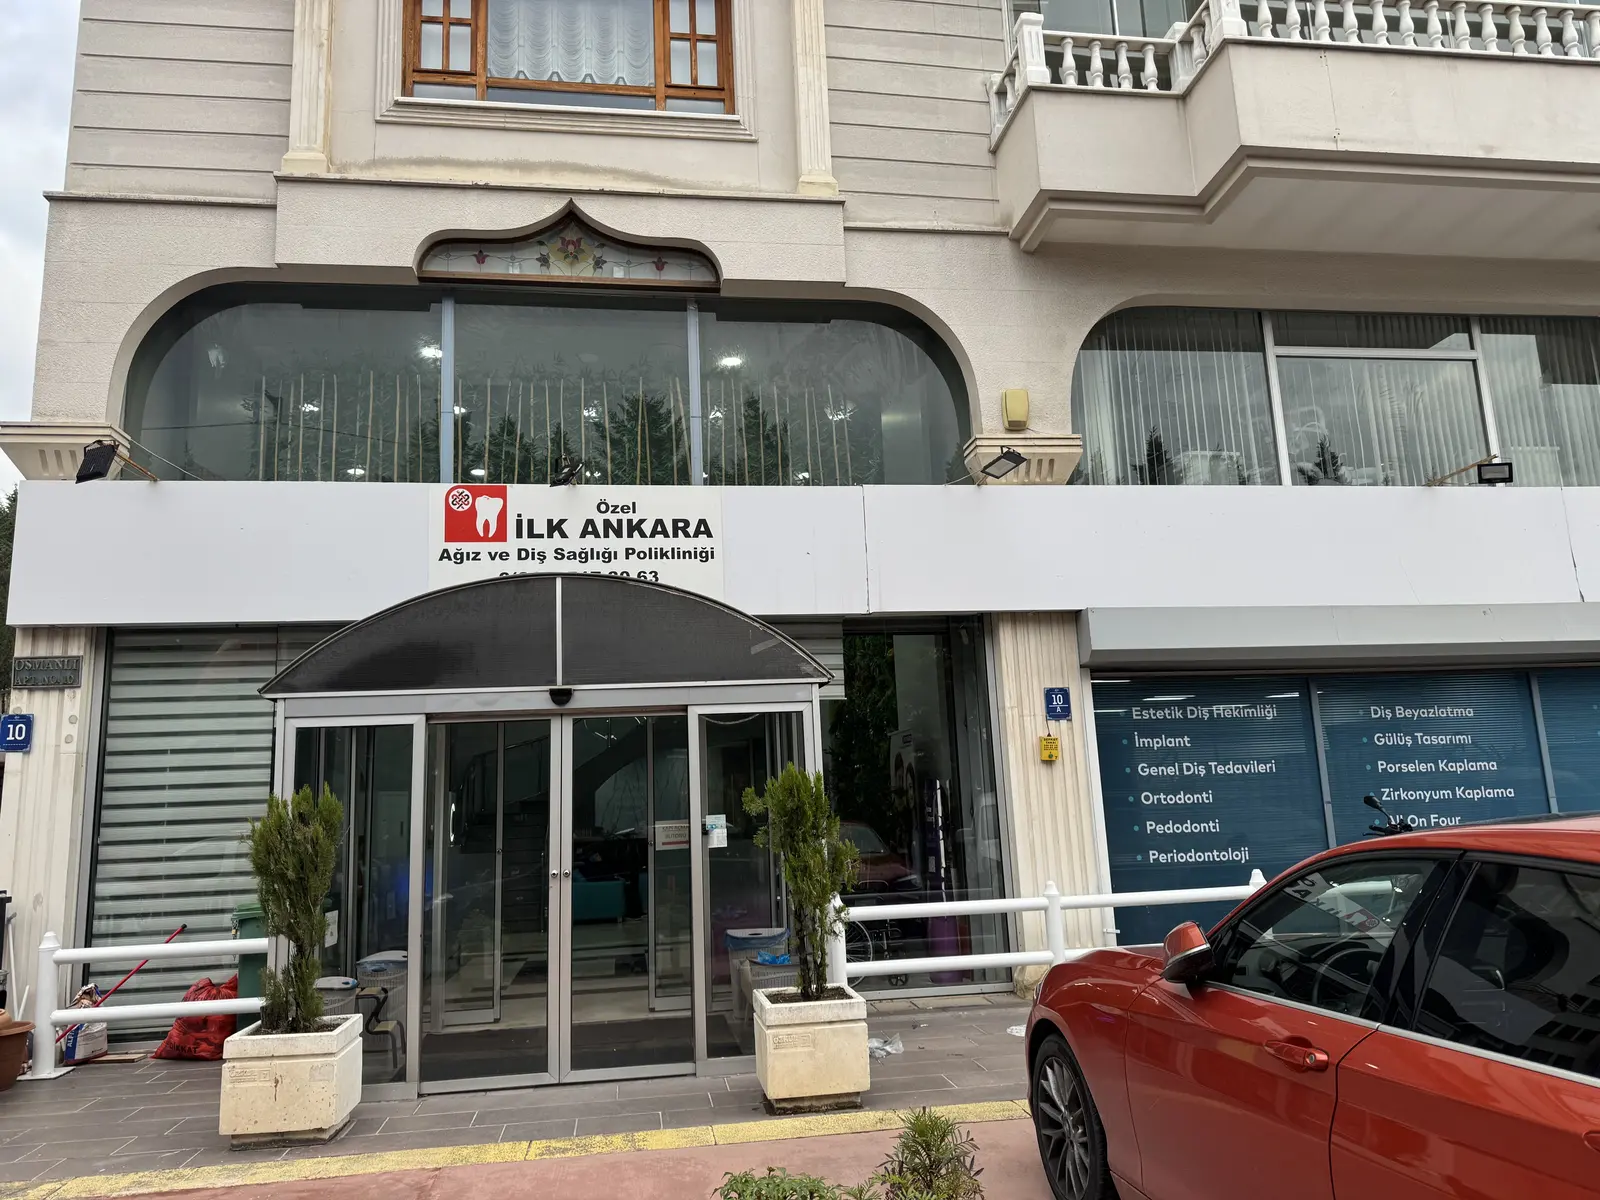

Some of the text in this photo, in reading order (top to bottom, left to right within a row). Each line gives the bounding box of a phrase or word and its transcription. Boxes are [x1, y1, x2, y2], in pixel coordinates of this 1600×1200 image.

[597, 499, 637, 514] Özel
[515, 513, 714, 539] İLK ANKARA
[438, 547, 715, 565] Ağız ve Diş Sağlığı Polikliniği
[15, 659, 78, 671] OSMANLI
[1051, 694, 1063, 705] 10
[1132, 704, 1277, 720] Estetik Diş Hekimliği
[1371, 705, 1474, 720] Diş Beyazlatma
[6, 723, 26, 741] 10
[1134, 732, 1191, 750] İmplant
[1374, 733, 1472, 747] Gülüş Tasarımı
[1138, 760, 1276, 777] Genel Diş Tedavileri
[1377, 759, 1498, 774] Porselen Kaplama
[1141, 790, 1213, 805] Ortodonti
[1381, 786, 1515, 803] Zirkonyum Kaplama
[1146, 819, 1220, 834] Pedodonti
[1407, 814, 1427, 827] On
[1430, 814, 1461, 827] Four
[1149, 847, 1250, 864] Periodontoloji
